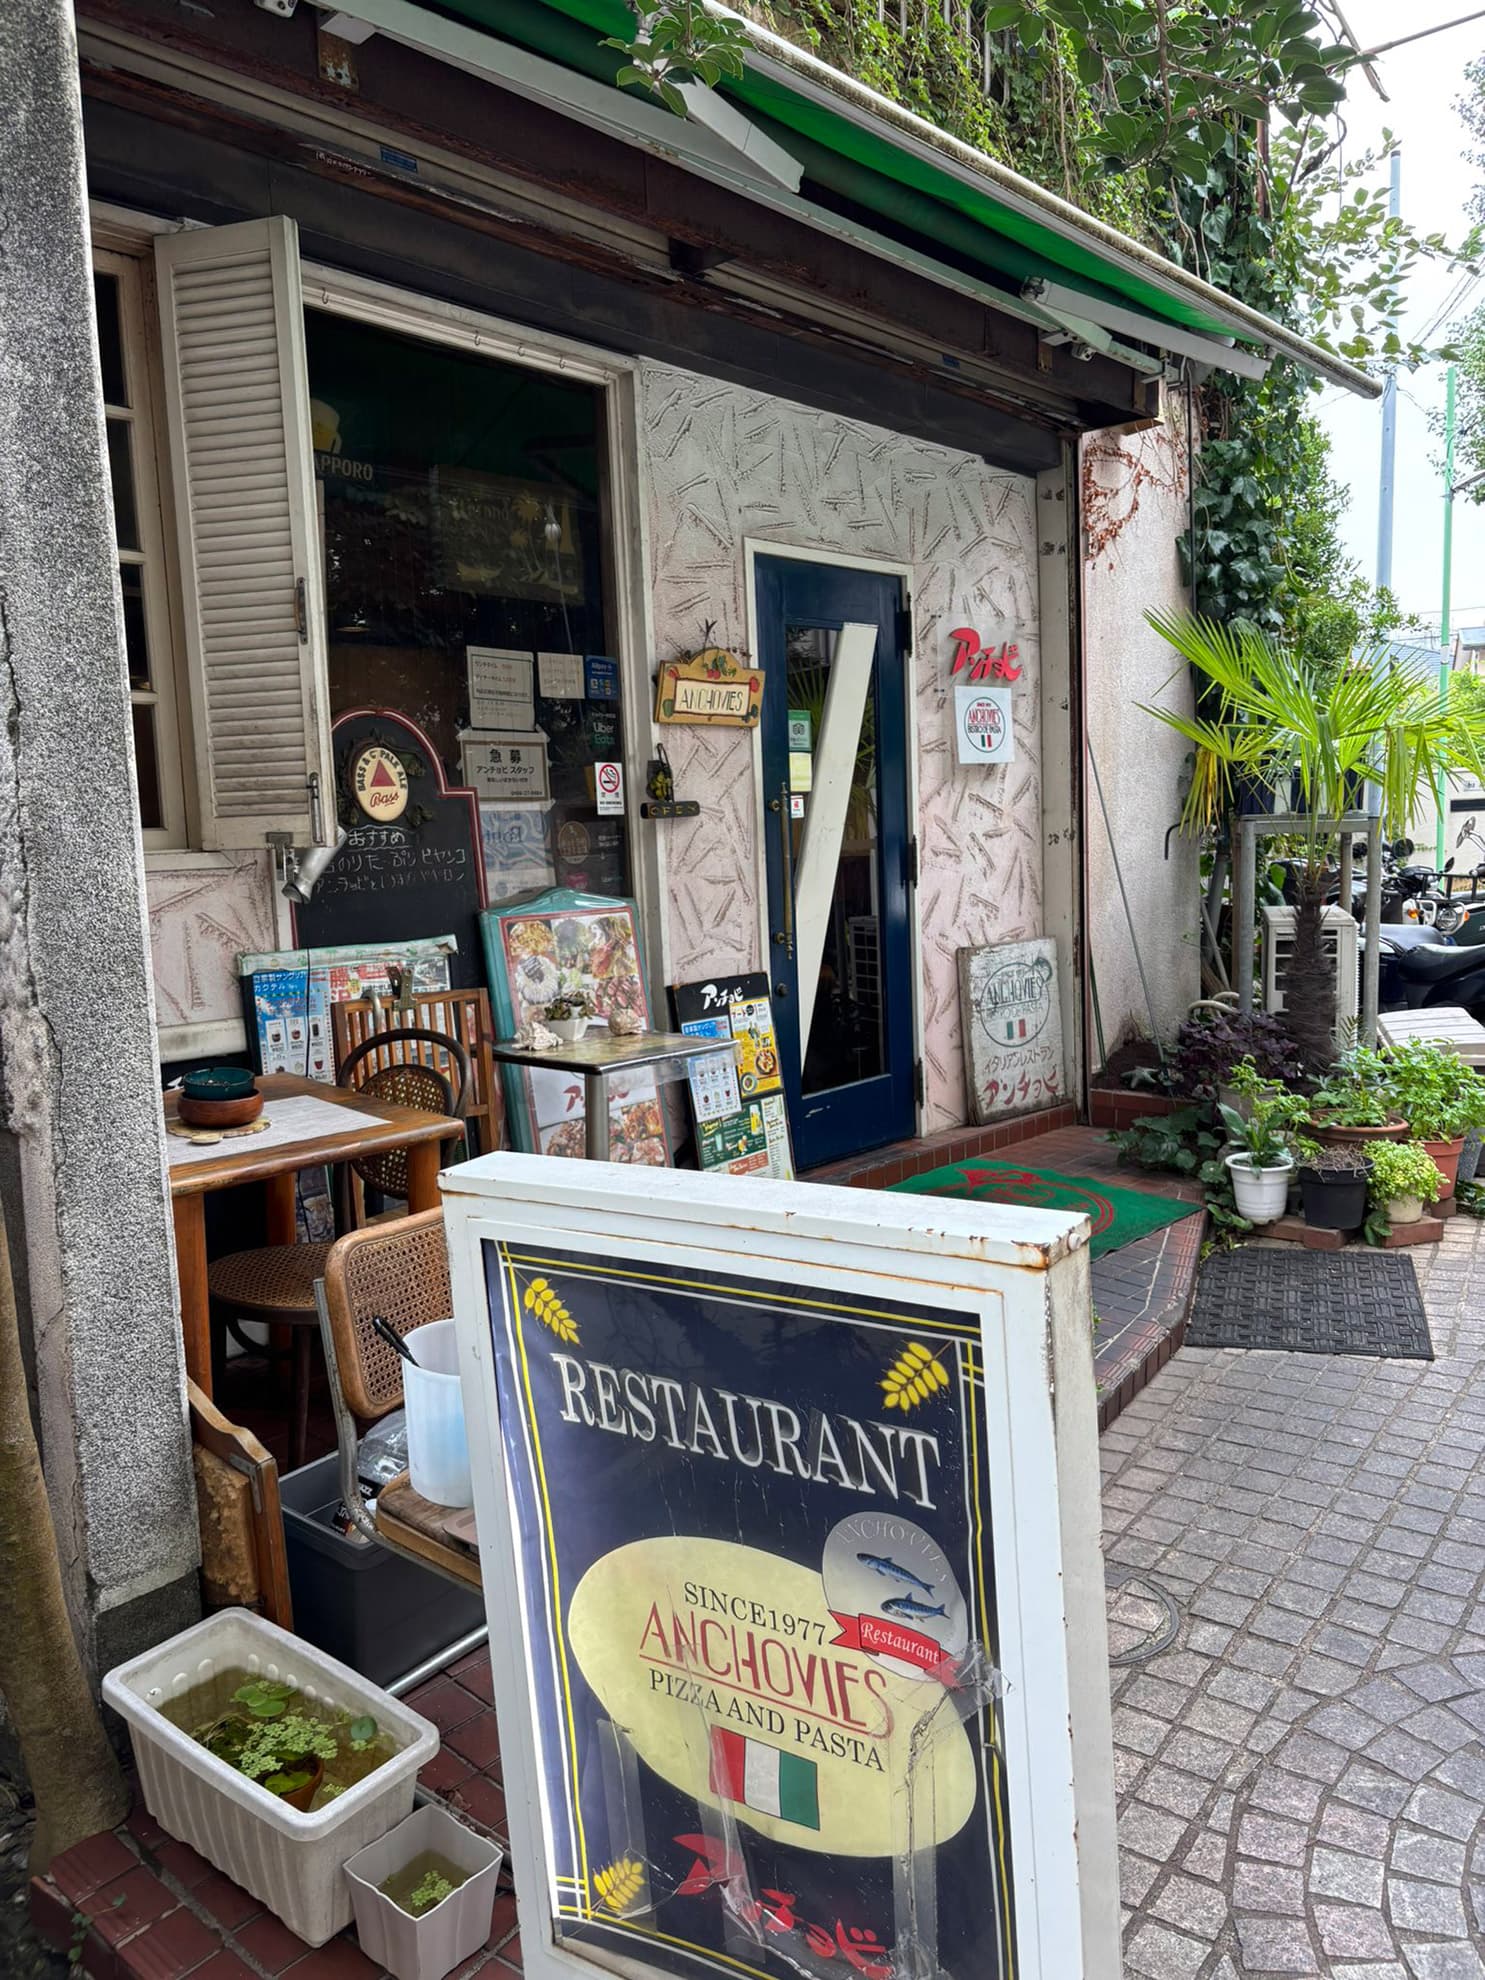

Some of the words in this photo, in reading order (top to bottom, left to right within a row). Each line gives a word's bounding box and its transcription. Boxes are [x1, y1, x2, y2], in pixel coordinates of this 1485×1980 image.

[313, 454, 374, 481] APPORO
[680, 688, 743, 711] ANCHOVIES
[593, 722, 614, 734] Uber
[357, 766, 366, 791] BASS
[380, 750, 400, 769] PALE
[397, 771, 408, 789] ALE
[370, 791, 399, 808] Bass
[348, 831, 406, 847] おすすめ
[700, 983, 744, 1010] アンチョビ
[984, 1046, 1055, 1074] イタリアンレストラン
[983, 1064, 1060, 1110] アンチョビ
[550, 1352, 942, 1511] RESTAURANT
[684, 1581, 826, 1646] SINCE1977
[860, 1622, 941, 1665] Restaurant
[640, 1600, 895, 1740] ANCHOVIES
[649, 1667, 723, 1714] PIZZA
[726, 1697, 785, 1735] AND
[794, 1718, 886, 1772] PASTA
